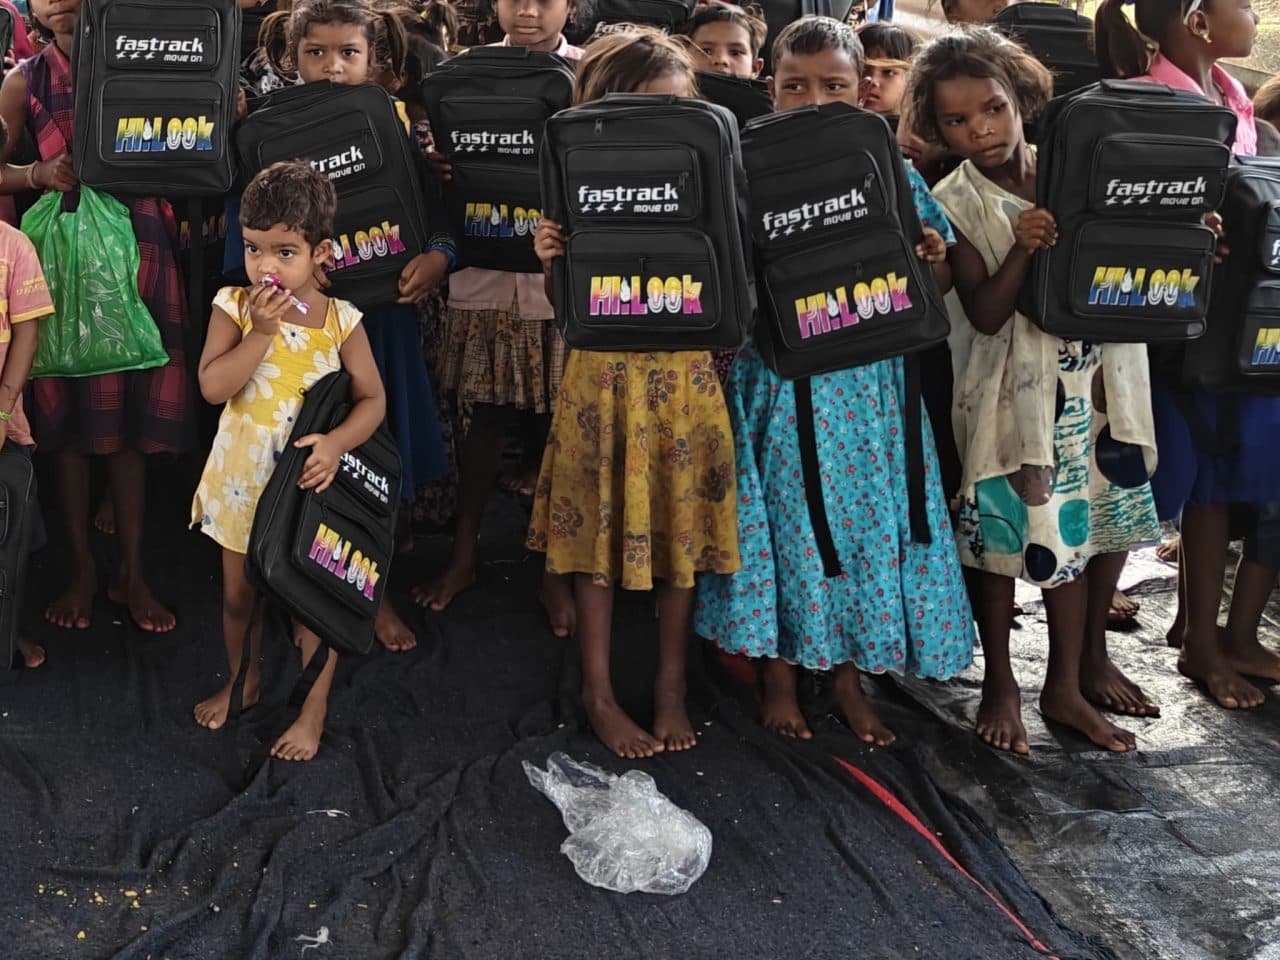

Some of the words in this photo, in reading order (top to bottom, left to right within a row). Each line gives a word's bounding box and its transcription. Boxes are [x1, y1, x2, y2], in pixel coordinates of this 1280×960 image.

[116, 35, 204, 53] fastrack
[451, 130, 534, 145] fastrack
[310, 145, 364, 172] track
[578, 183, 678, 204] fastrack
[1106, 176, 1207, 196] fastrack
[762, 188, 866, 231] fastrack
[340, 451, 390, 495] astrack
